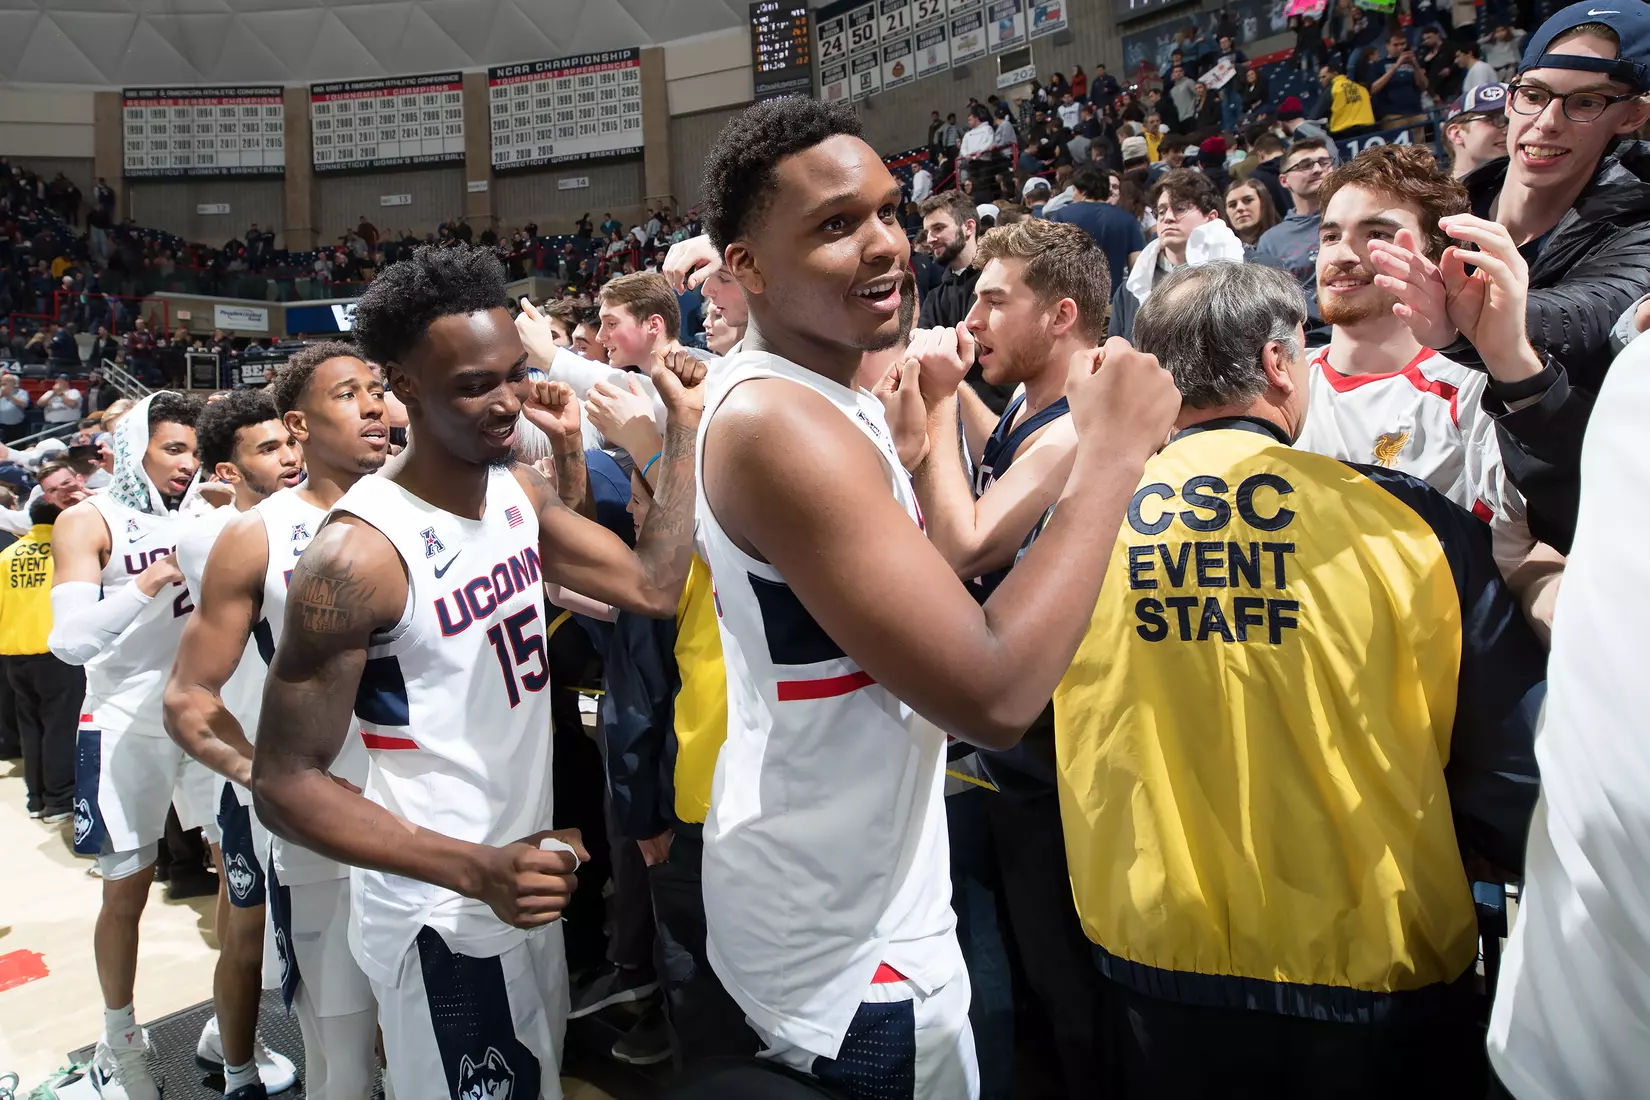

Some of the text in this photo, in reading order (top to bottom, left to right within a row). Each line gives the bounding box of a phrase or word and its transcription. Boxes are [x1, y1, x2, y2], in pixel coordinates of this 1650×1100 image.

[919, 0, 939, 18] 52
[887, 11, 904, 32] 21
[852, 25, 872, 44] 50
[822, 36, 842, 57] 24
[497, 50, 631, 76] NCAA CHAMPIONSHIP
[497, 62, 633, 84] TOURNAMENT APPEARANCES
[1012, 67, 1036, 82] 202
[325, 85, 449, 101] TOURNAMENT CHAMPIONS
[515, 101, 529, 111] 1997
[622, 86, 638, 96] 2002
[514, 117, 531, 127] 2004
[579, 108, 595, 118] 2007
[402, 128, 418, 138] 2014
[516, 133, 531, 143] 2011
[537, 129, 552, 140] 2012
[559, 126, 574, 137] 2013
[580, 124, 596, 134] 2014
[602, 121, 617, 131] 2015
[495, 152, 510, 162] 2017
[1127, 473, 1296, 535] CSC
[15, 542, 50, 556] CSC
[11, 557, 48, 572] EVENT
[1128, 541, 1295, 590] EVENT
[11, 573, 47, 588] STAFF
[433, 542, 542, 636] UCONN
[1135, 596, 1299, 644] STAFF
[487, 604, 550, 708] 15
